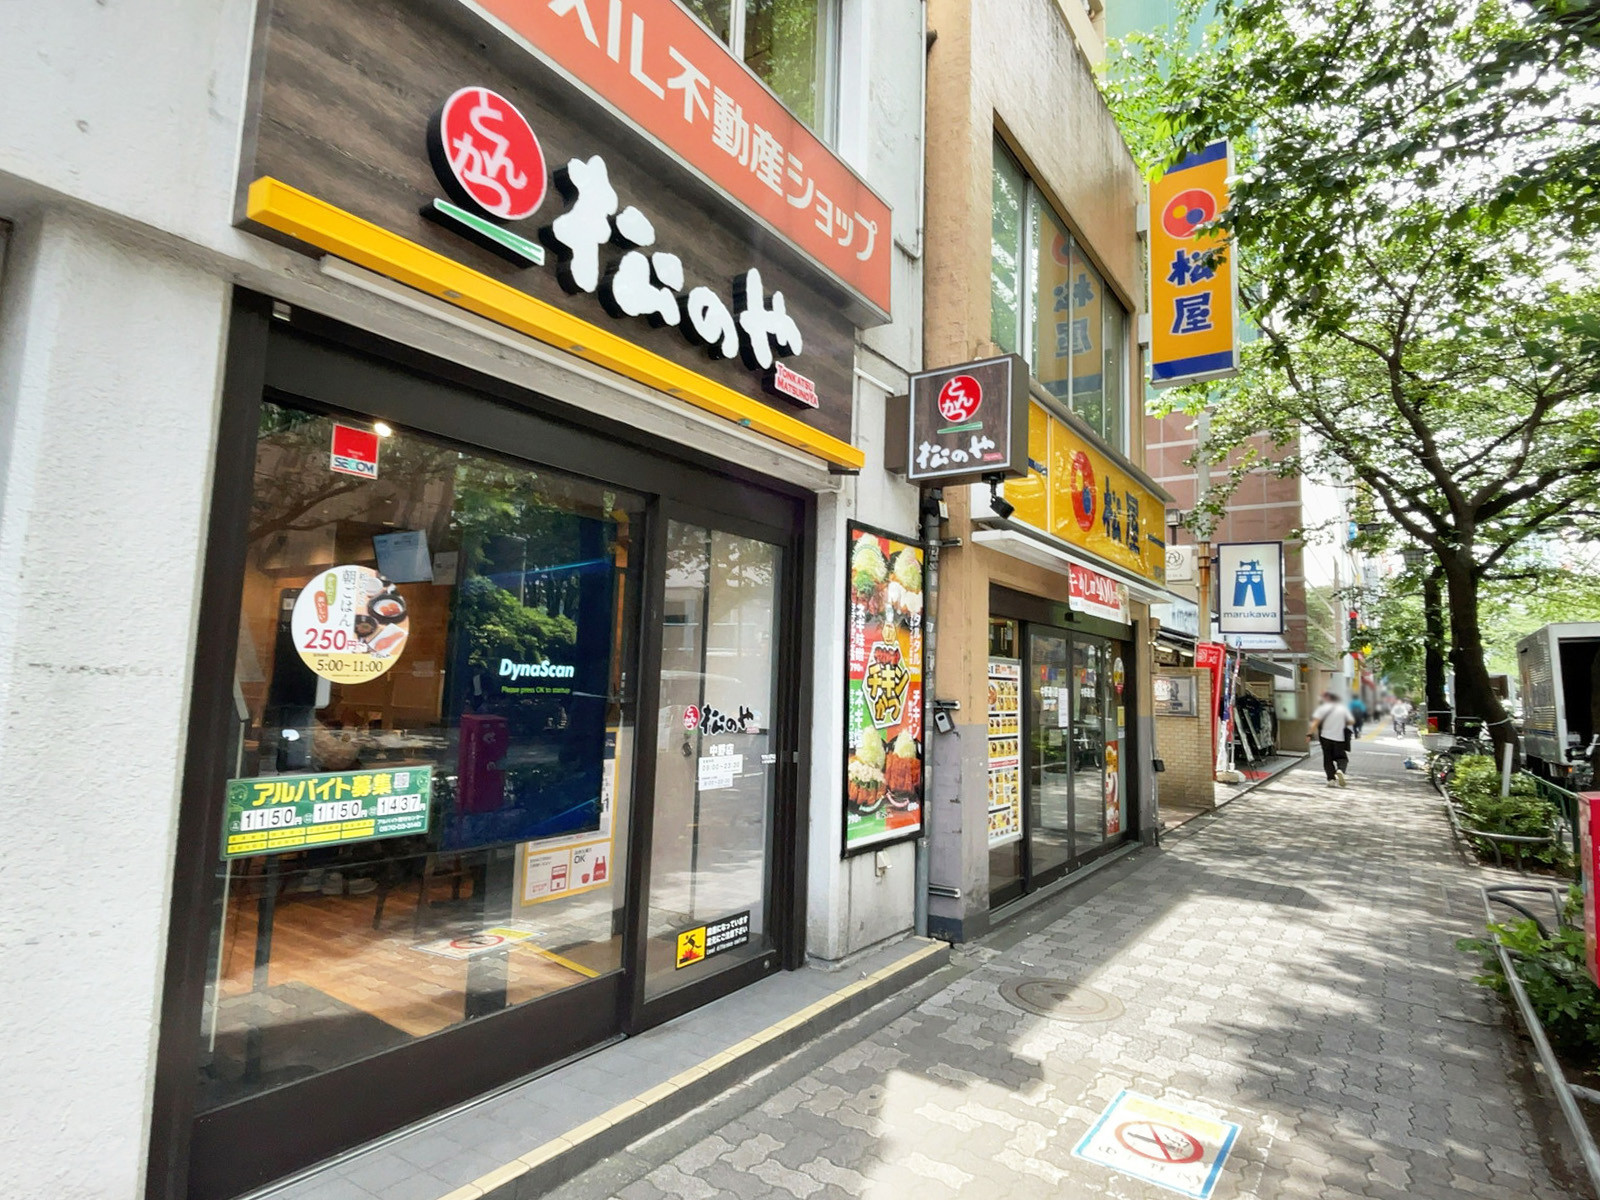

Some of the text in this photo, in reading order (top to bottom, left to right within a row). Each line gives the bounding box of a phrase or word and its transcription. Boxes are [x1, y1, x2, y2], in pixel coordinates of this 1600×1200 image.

[552, 154, 803, 370] 松のや
[1167, 249, 1215, 335] 松屋
[777, 363, 814, 392] TONKATSU
[777, 376, 818, 406] MATSUNOYA
[334, 457, 375, 474] SECOM
[916, 435, 996, 469] 松のや
[1103, 475, 1141, 555] 松屋
[1223, 611, 1277, 619] marukawa
[499, 658, 575, 680] DynaScan
[701, 704, 754, 735] 松のや
[252, 773, 392, 807] アルバイト募集
[573, 854, 586, 864] OK
